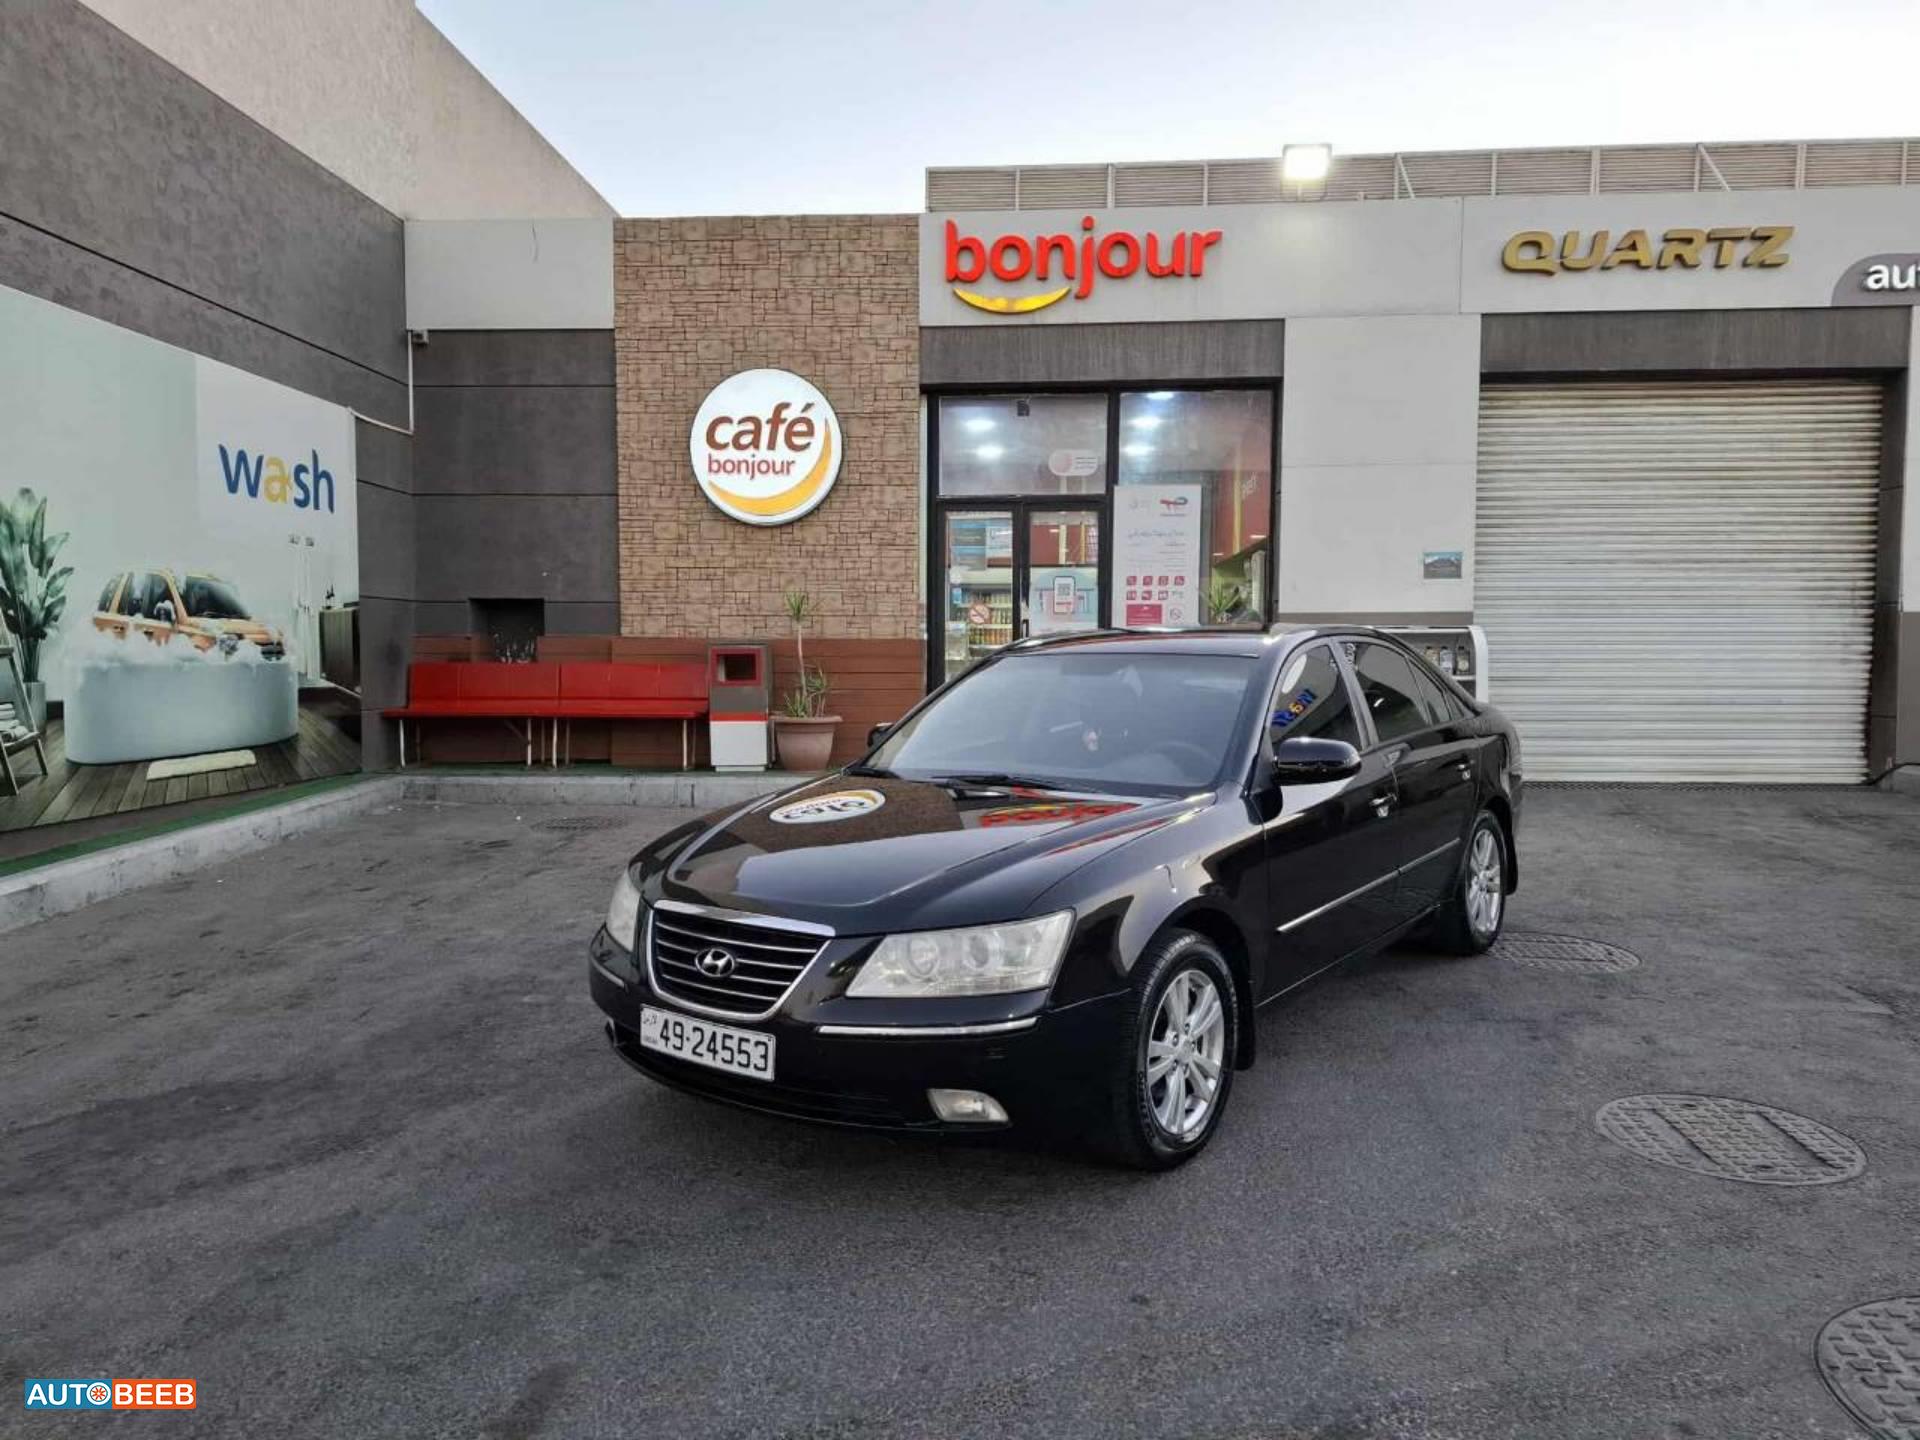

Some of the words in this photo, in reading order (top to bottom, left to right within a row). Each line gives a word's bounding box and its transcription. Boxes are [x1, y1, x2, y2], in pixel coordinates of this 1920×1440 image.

[945, 215, 1223, 300] bonjour
[1501, 225, 1795, 277] QUARTZ
[1866, 264, 1920, 291] au
[705, 401, 816, 453] café
[218, 443, 335, 514] wash
[707, 453, 796, 481] bonjour
[660, 1018, 769, 1072] 49-24553
